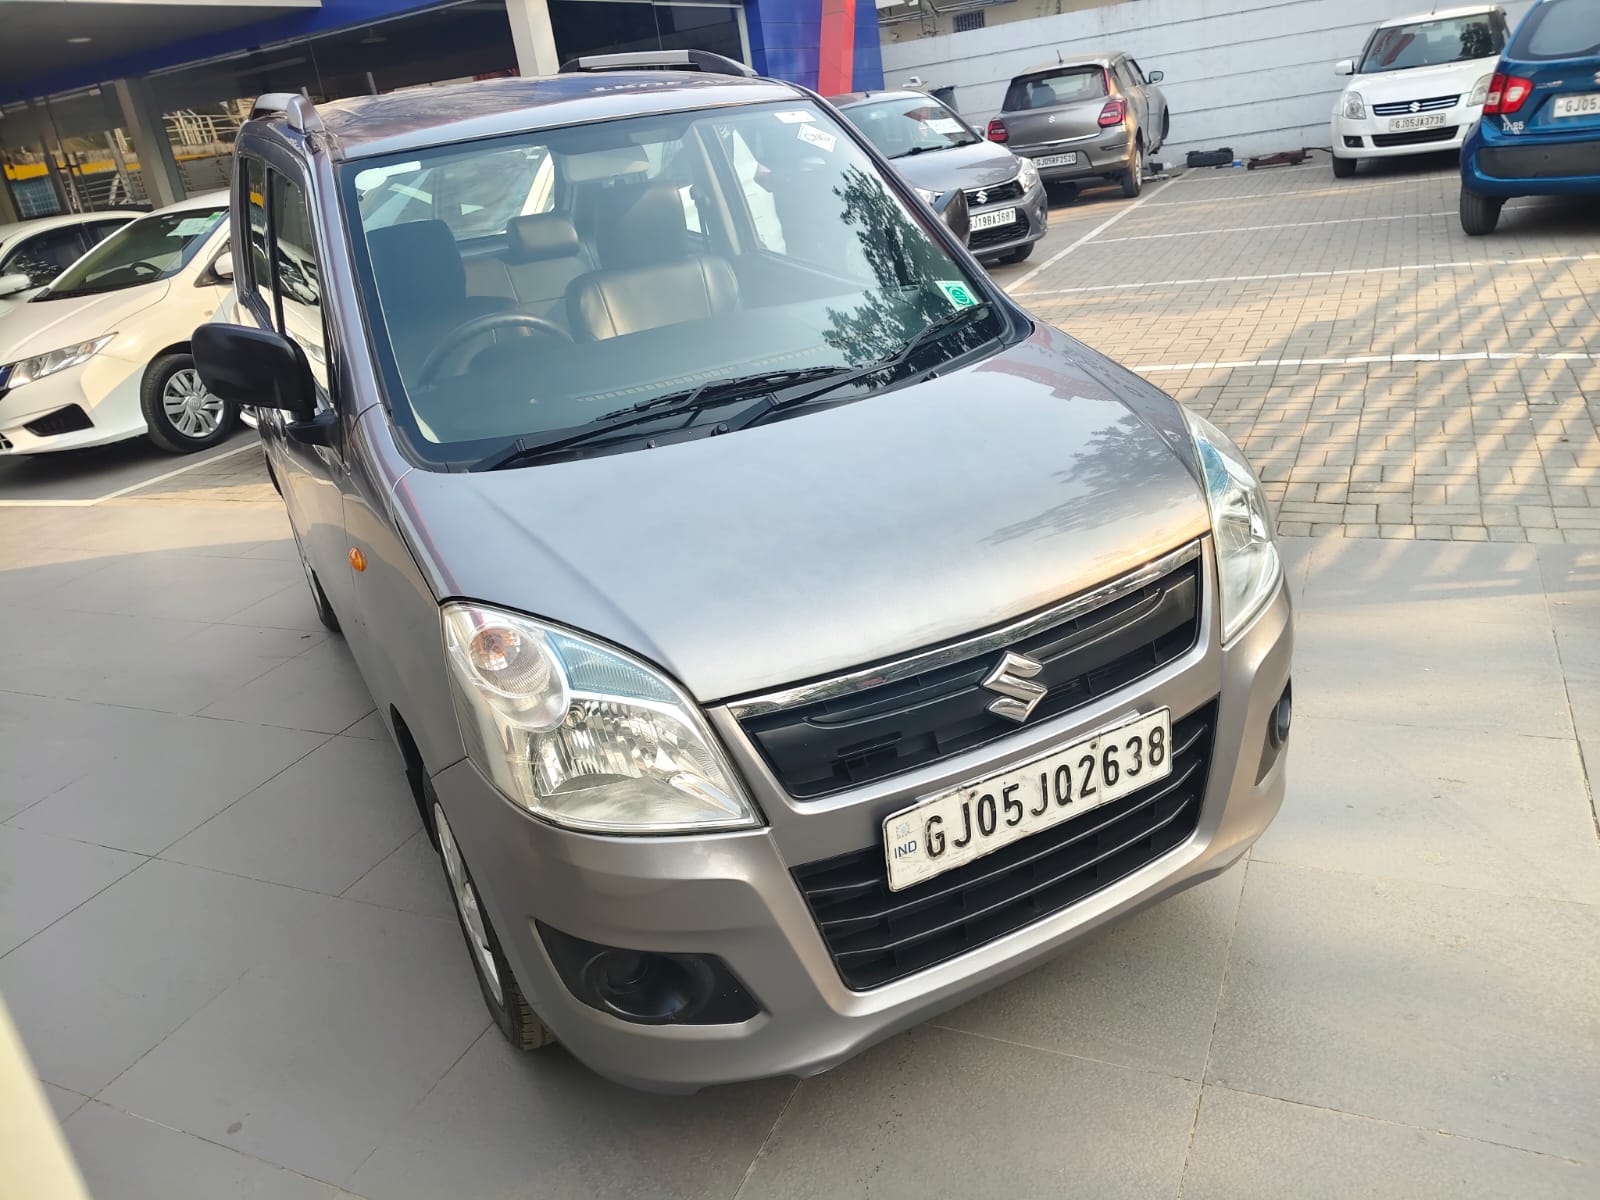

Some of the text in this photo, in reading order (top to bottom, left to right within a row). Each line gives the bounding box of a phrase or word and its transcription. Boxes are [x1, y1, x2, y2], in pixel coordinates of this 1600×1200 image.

[1565, 97, 1600, 112] GJ05
[894, 725, 1165, 860] IND GJ05JQ2638
